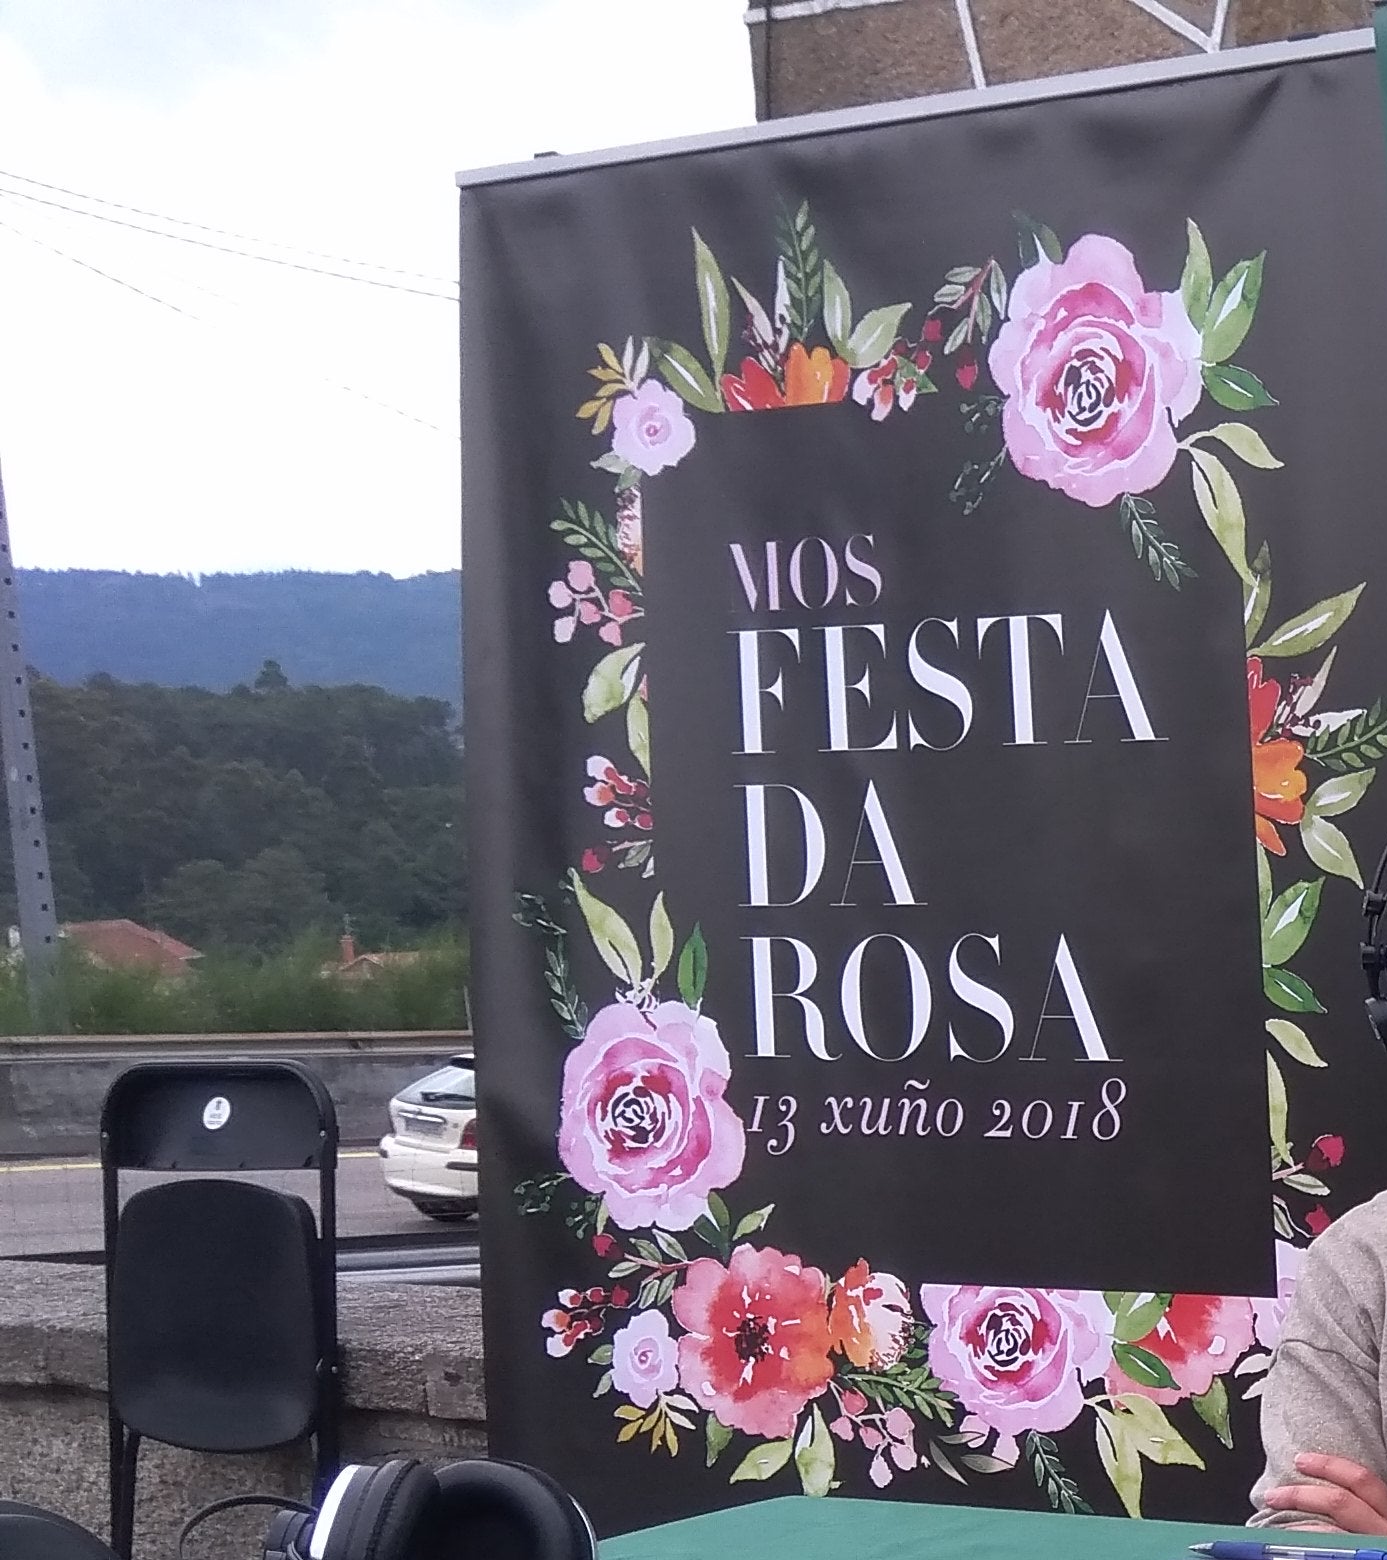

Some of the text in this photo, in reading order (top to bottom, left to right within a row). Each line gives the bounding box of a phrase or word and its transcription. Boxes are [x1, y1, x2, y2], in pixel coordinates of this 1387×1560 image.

[729, 533, 885, 613] MOS
[726, 609, 1169, 756] FESTA
[737, 778, 927, 909] DA
[743, 931, 1123, 1063] ROSA
[745, 1077, 1129, 1156] 13 xuño 2018
